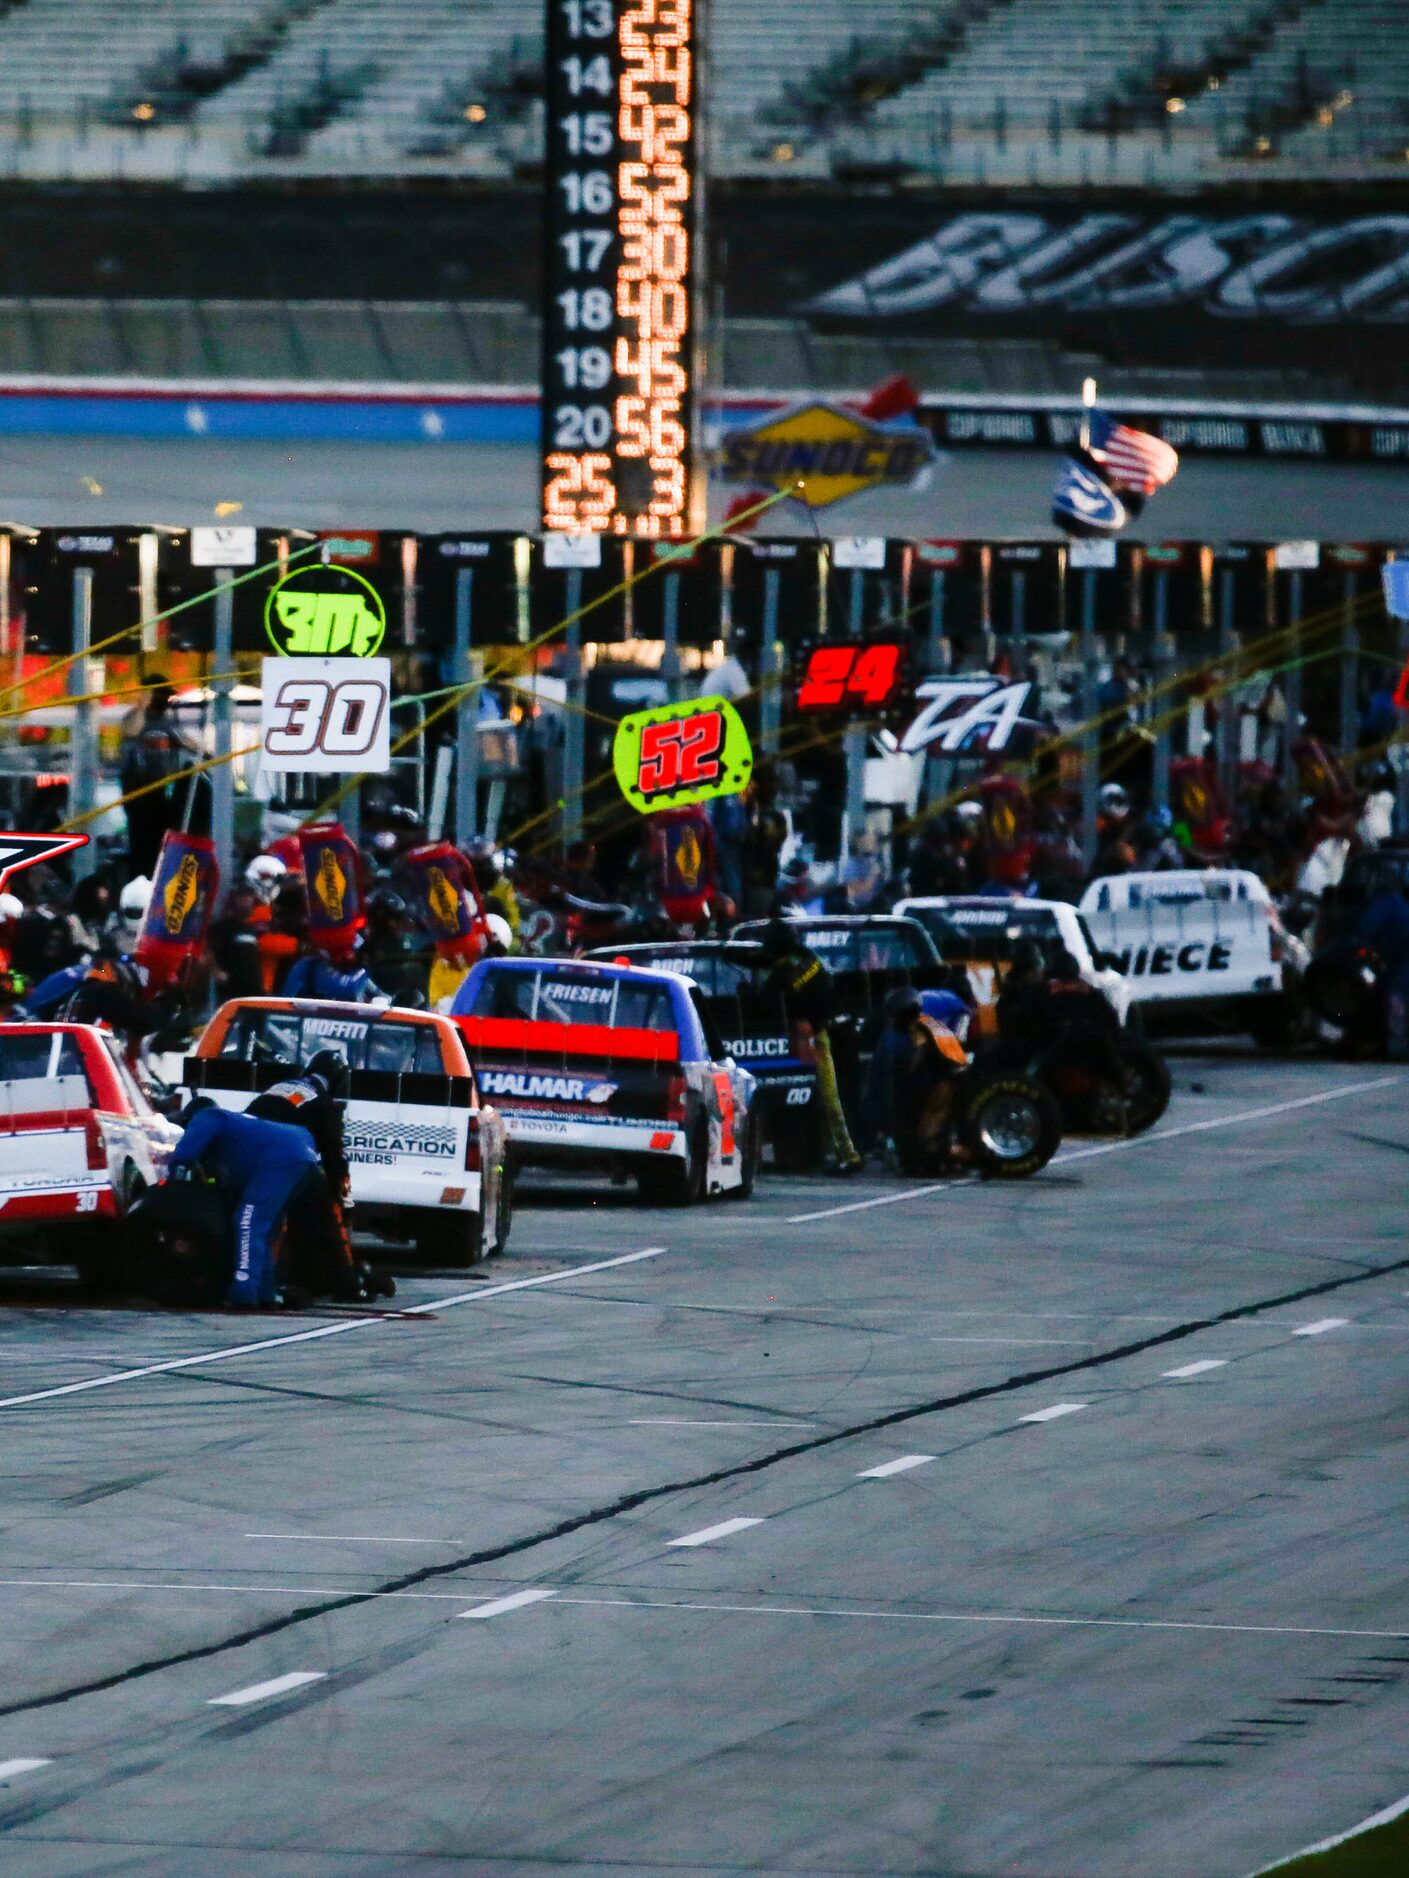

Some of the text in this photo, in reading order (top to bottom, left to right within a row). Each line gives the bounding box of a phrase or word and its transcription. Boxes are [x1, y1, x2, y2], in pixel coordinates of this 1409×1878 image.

[562, 0, 614, 38] 13
[560, 46, 690, 105] 14 24
[560, 112, 614, 155] 15
[560, 171, 613, 214] 16
[559, 221, 688, 281] 17 30
[556, 279, 687, 338] 18 40
[556, 336, 687, 398] 19 45
[554, 396, 686, 457] 20 56
[545, 453, 686, 516] 25 3
[798, 644, 899, 707] 24
[265, 680, 387, 755] 30
[638, 712, 723, 793] 52
[1093, 940, 1232, 975] NIECE
[543, 982, 614, 1004] FRIESEN
[303, 1018, 369, 1040] MOFFITT
[723, 1038, 789, 1057] POLICE
[482, 1072, 584, 1100] HALMAR
[521, 1121, 567, 1133] TOYOTA
[76, 1192, 99, 1212] 30
